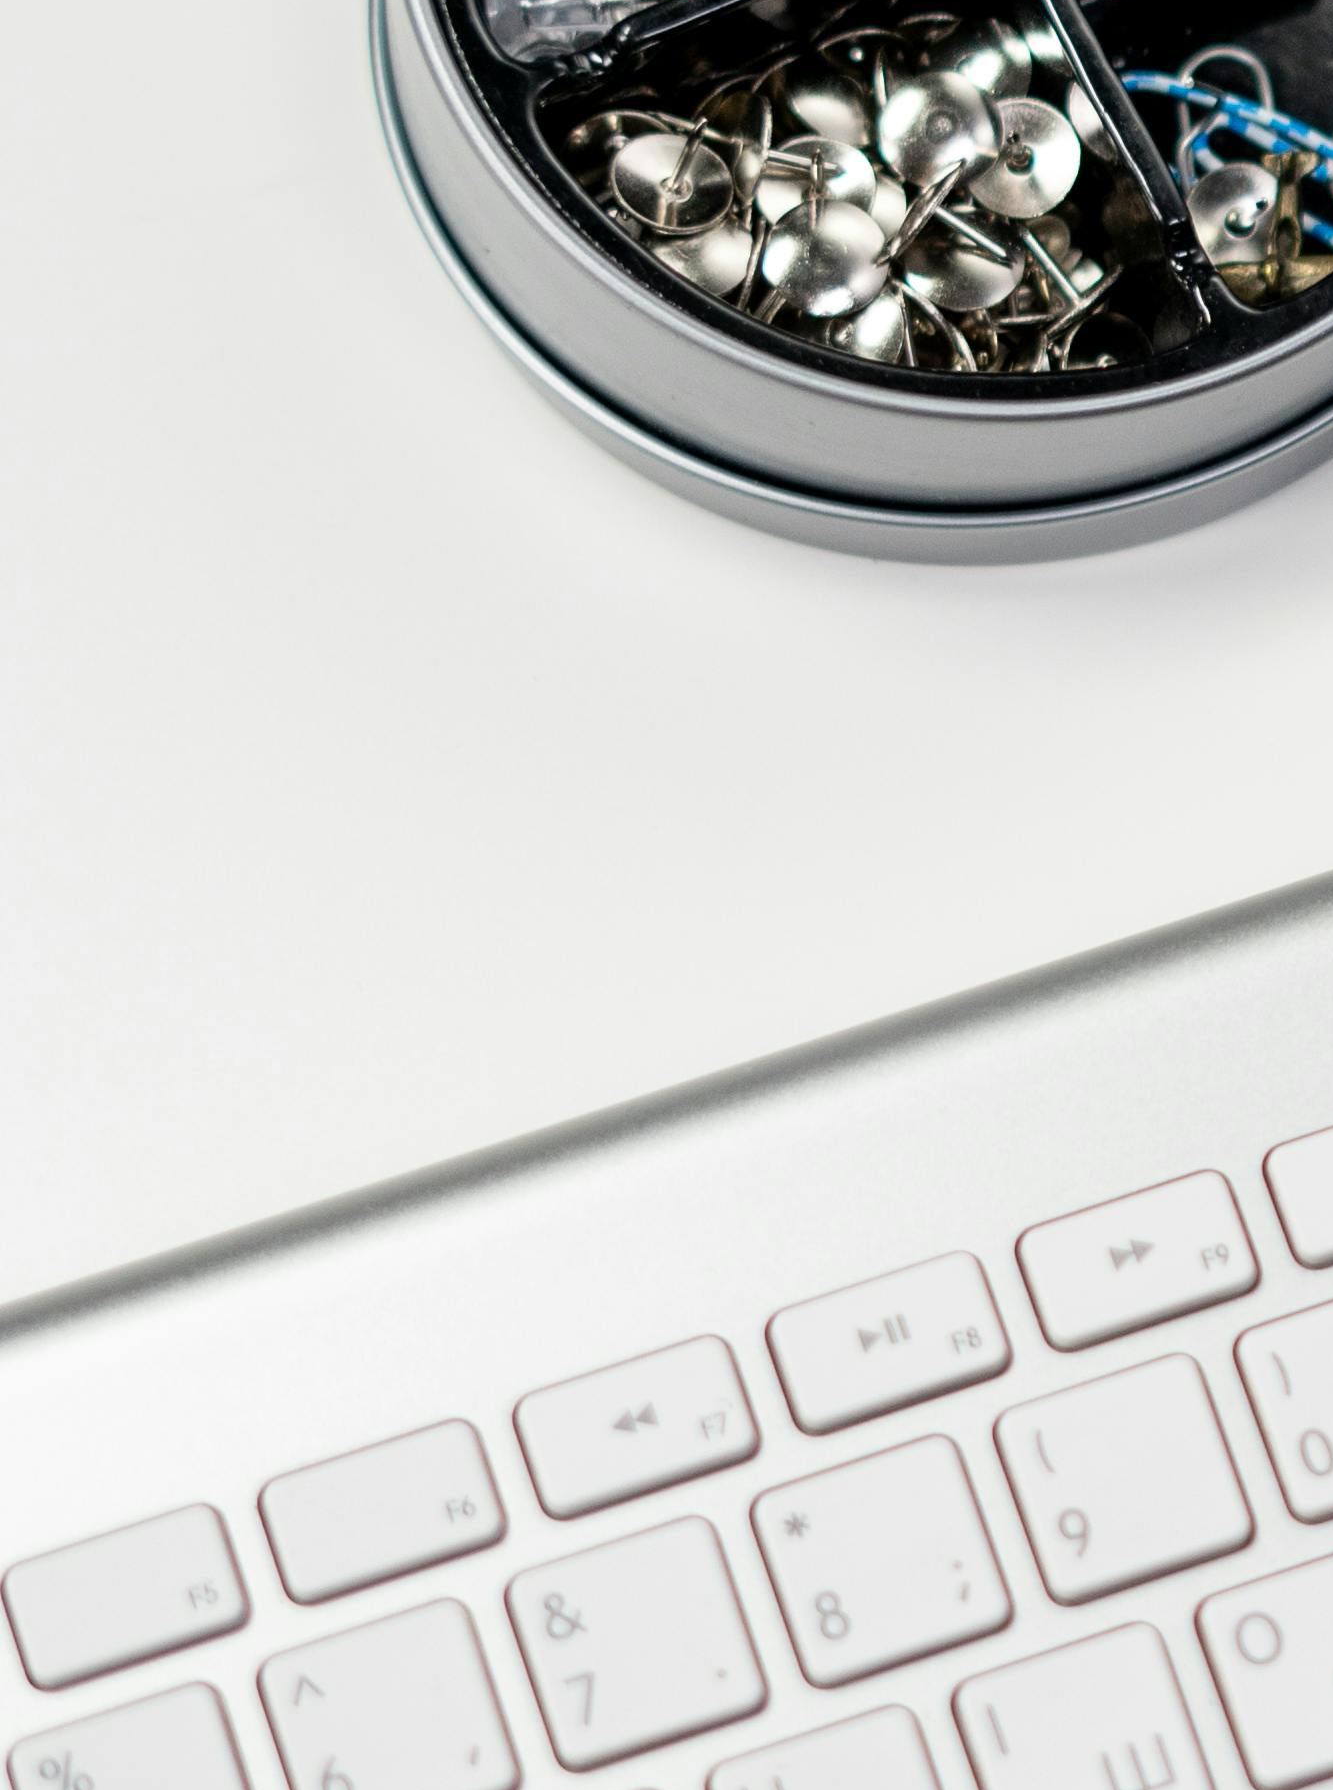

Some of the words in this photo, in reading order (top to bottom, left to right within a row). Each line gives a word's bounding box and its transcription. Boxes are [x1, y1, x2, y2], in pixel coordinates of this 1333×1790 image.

[1199, 1243, 1230, 1271] F9
[950, 1326, 982, 1354] F8
[698, 1411, 727, 1440] F7
[444, 1496, 477, 1523] F6
[1056, 1507, 1091, 1558] 9
[186, 1581, 219, 1610] F5
[814, 1590, 852, 1641] 8
[1232, 1611, 1284, 1667] O
[563, 1671, 595, 1727] 7
